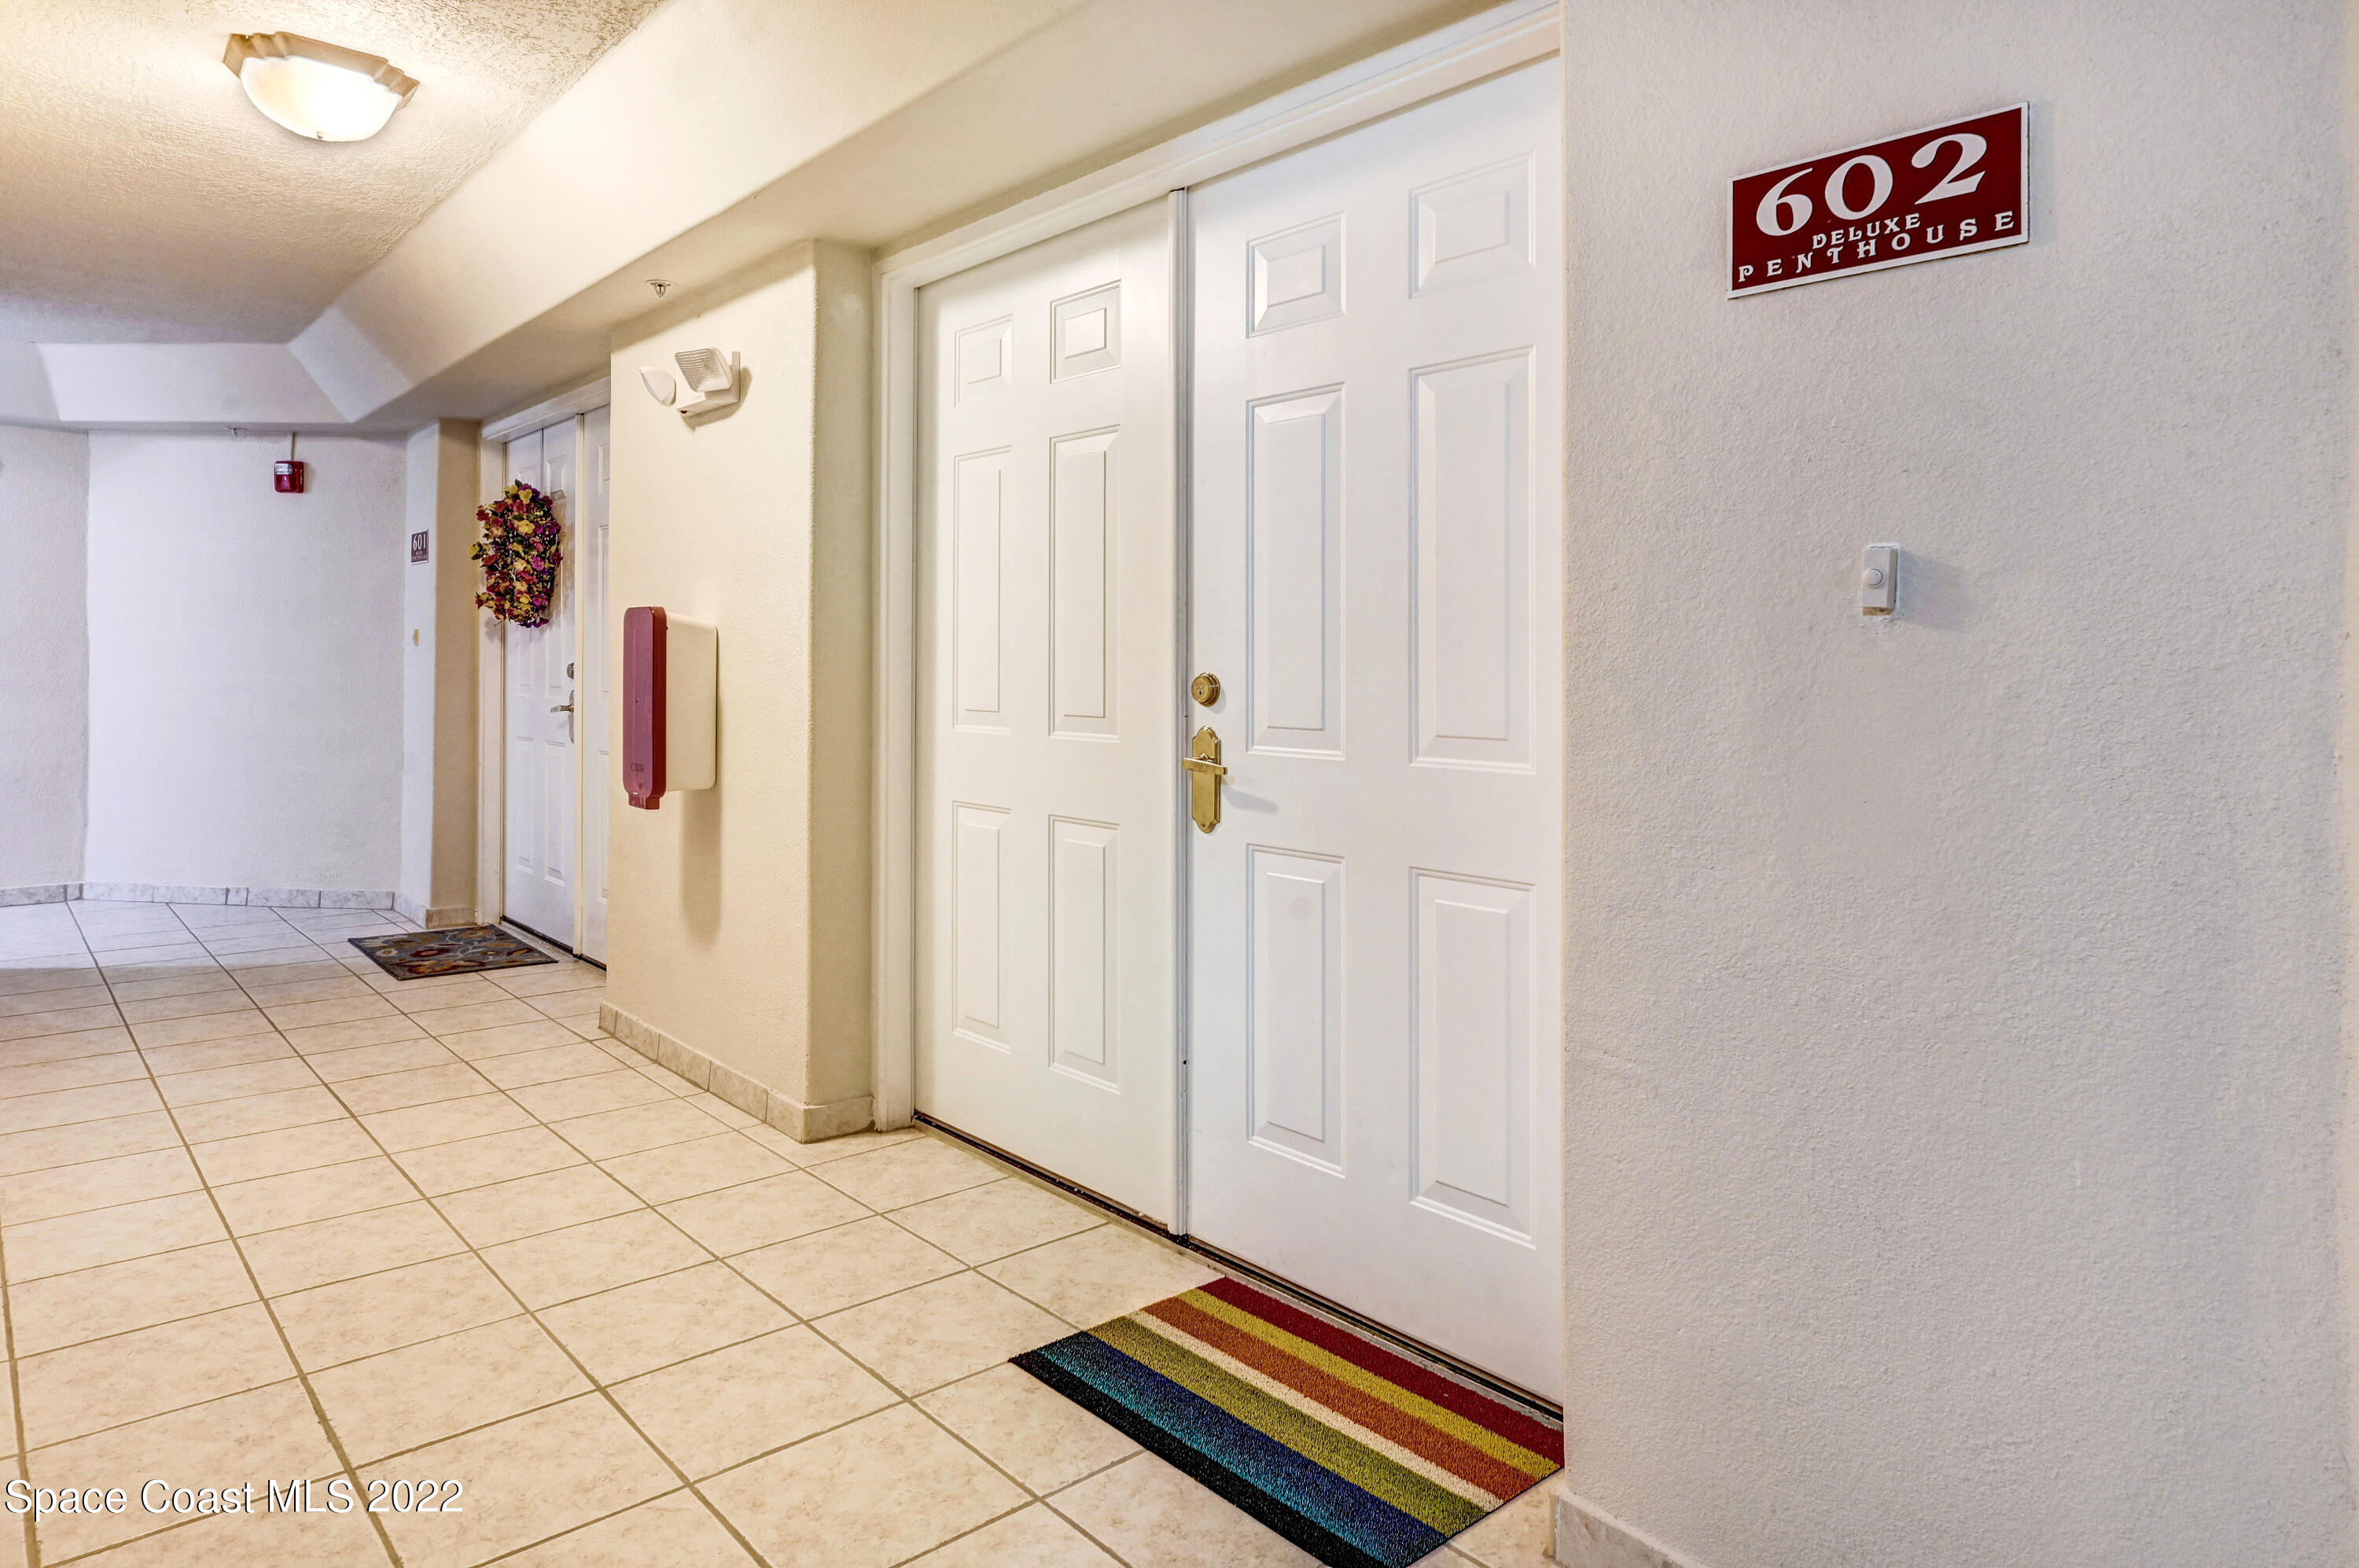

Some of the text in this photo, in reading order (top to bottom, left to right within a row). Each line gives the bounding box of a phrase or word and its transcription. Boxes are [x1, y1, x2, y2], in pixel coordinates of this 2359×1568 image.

[1756, 133, 1988, 236] 602
[1738, 211, 2015, 282] PENTHOUSE
[1812, 212, 1921, 249] DELUXE
[413, 534, 426, 551] 601
